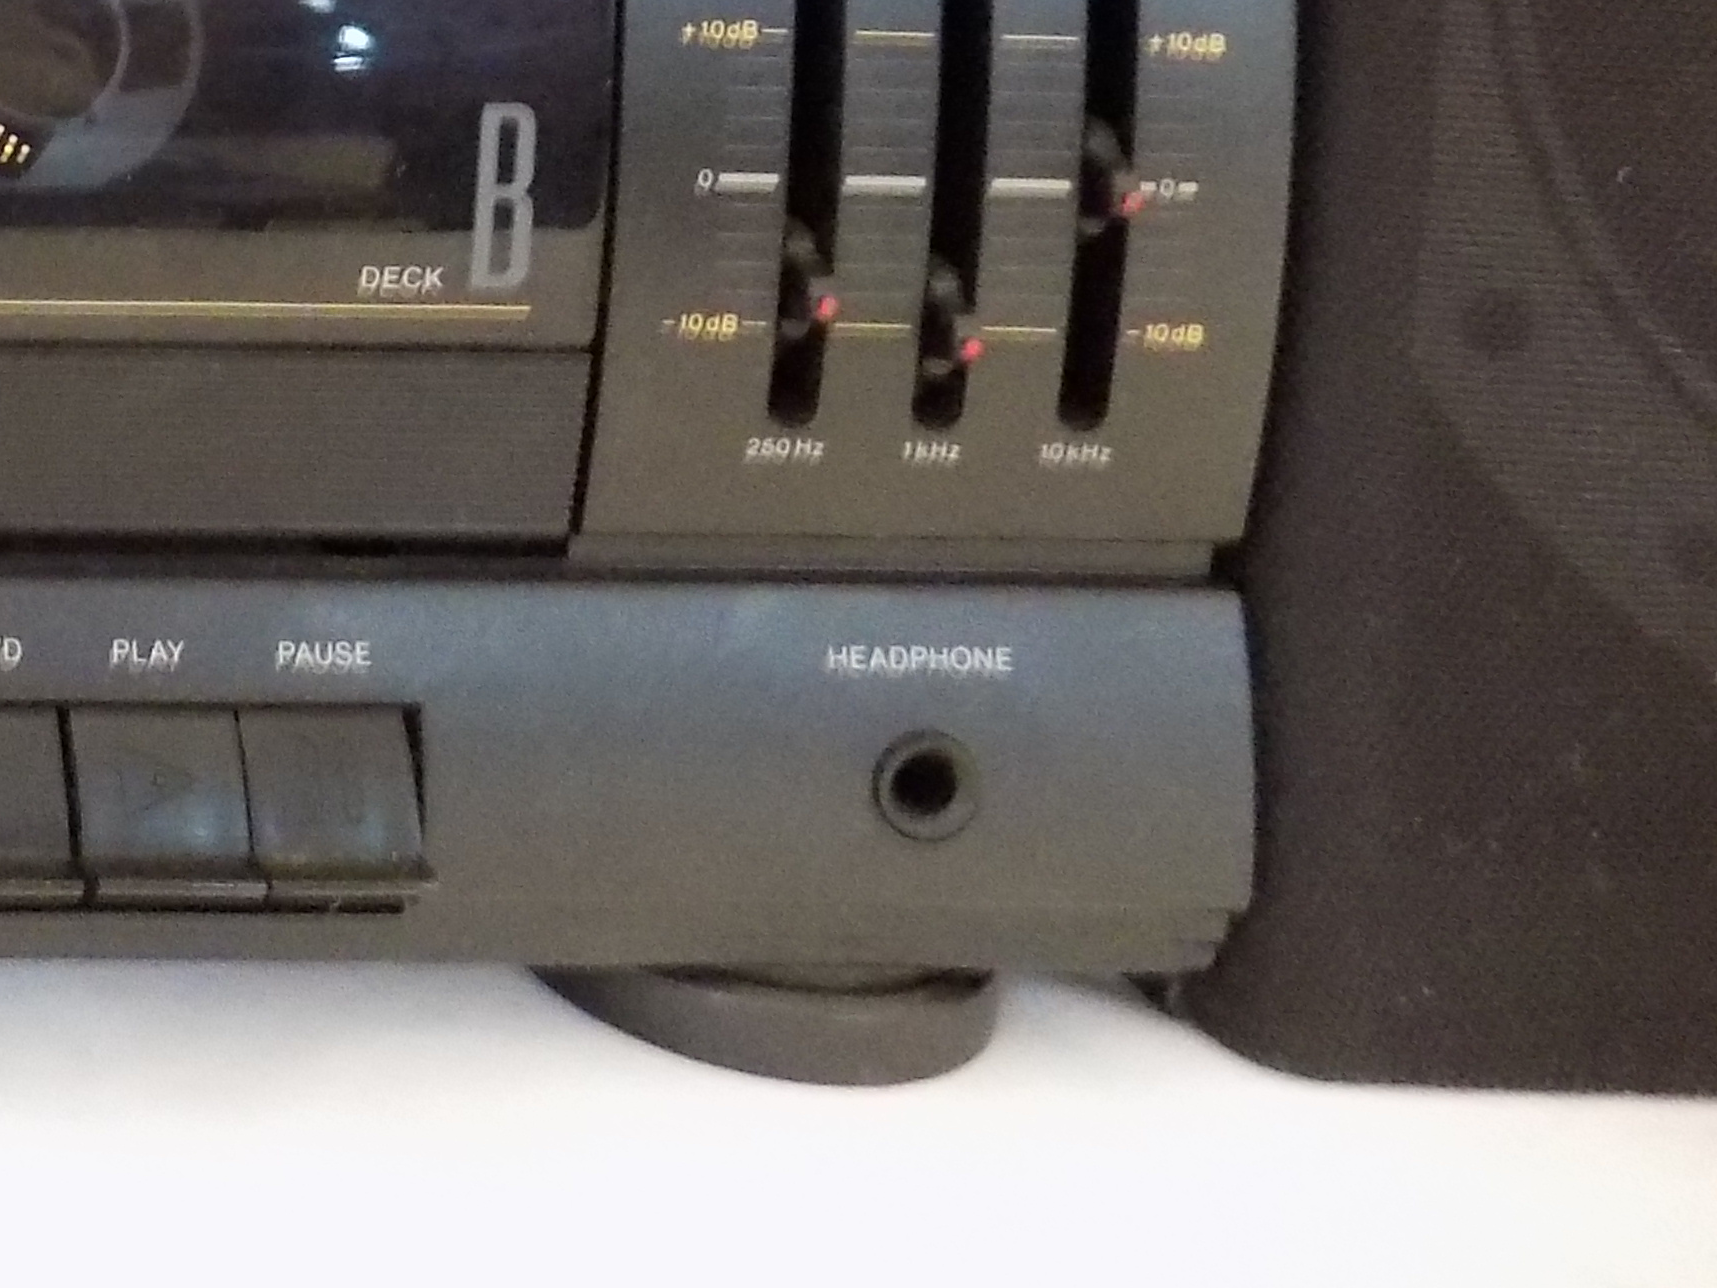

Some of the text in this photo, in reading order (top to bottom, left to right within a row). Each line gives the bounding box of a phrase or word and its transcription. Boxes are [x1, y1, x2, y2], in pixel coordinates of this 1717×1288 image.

[468, 101, 539, 292] B
[695, 169, 714, 195] 0
[359, 265, 444, 299] DECK
[109, 638, 185, 672] PLAY
[276, 640, 372, 673] PAUSE
[826, 644, 1014, 679] HEADPHONE
